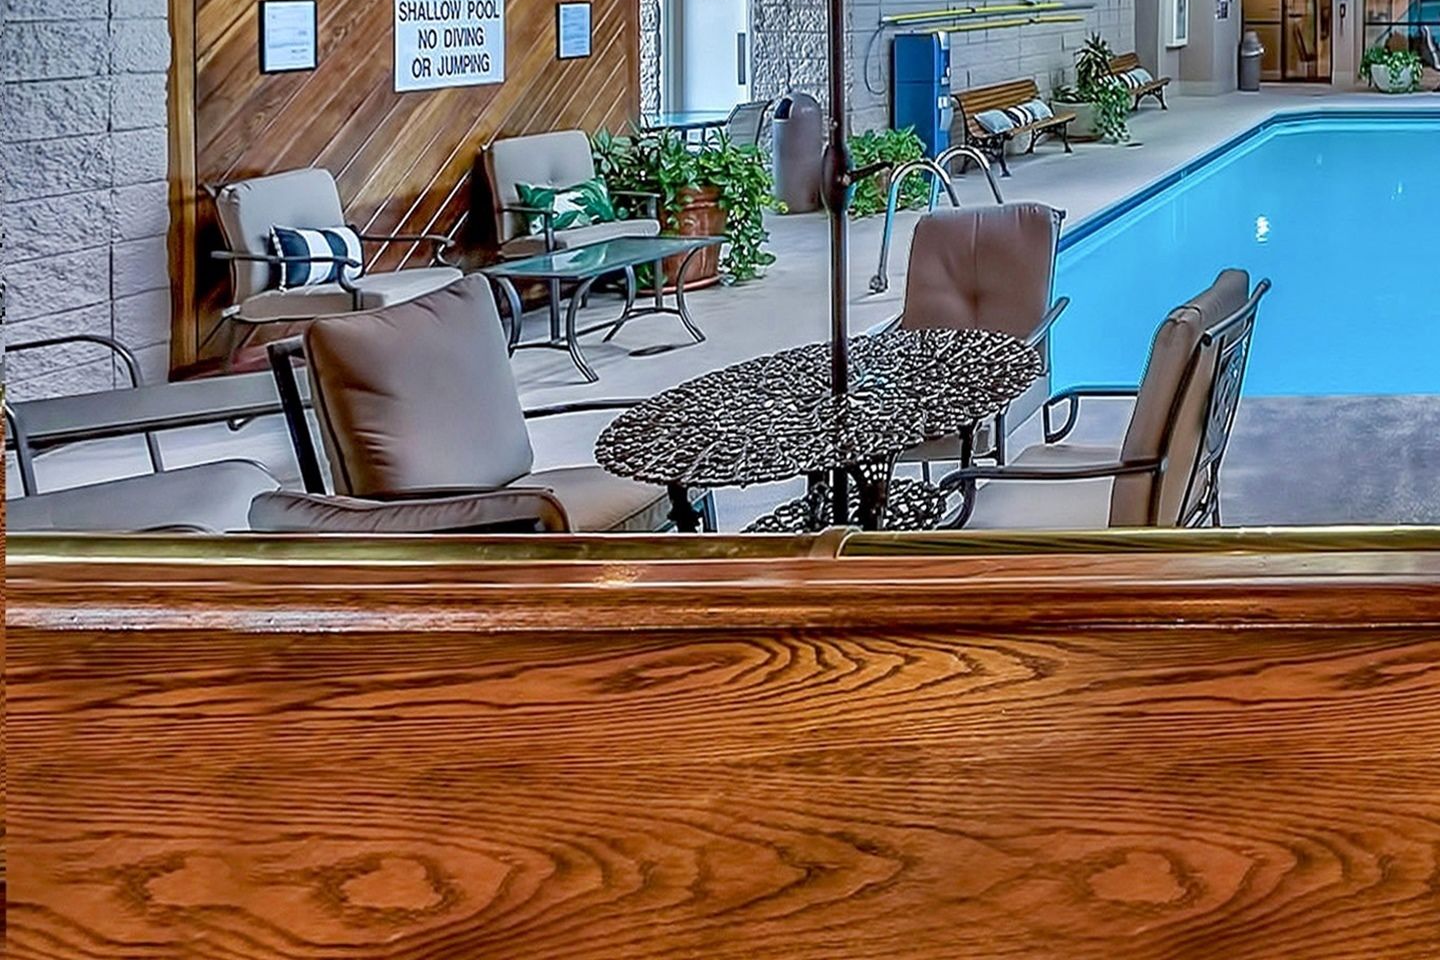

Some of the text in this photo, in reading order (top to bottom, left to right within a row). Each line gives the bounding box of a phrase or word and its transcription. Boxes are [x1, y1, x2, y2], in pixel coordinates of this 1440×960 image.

[399, 0, 500, 21] SHALLOW POOL
[418, 27, 484, 49] NO DIVING
[412, 53, 490, 78] OR JUMPING
